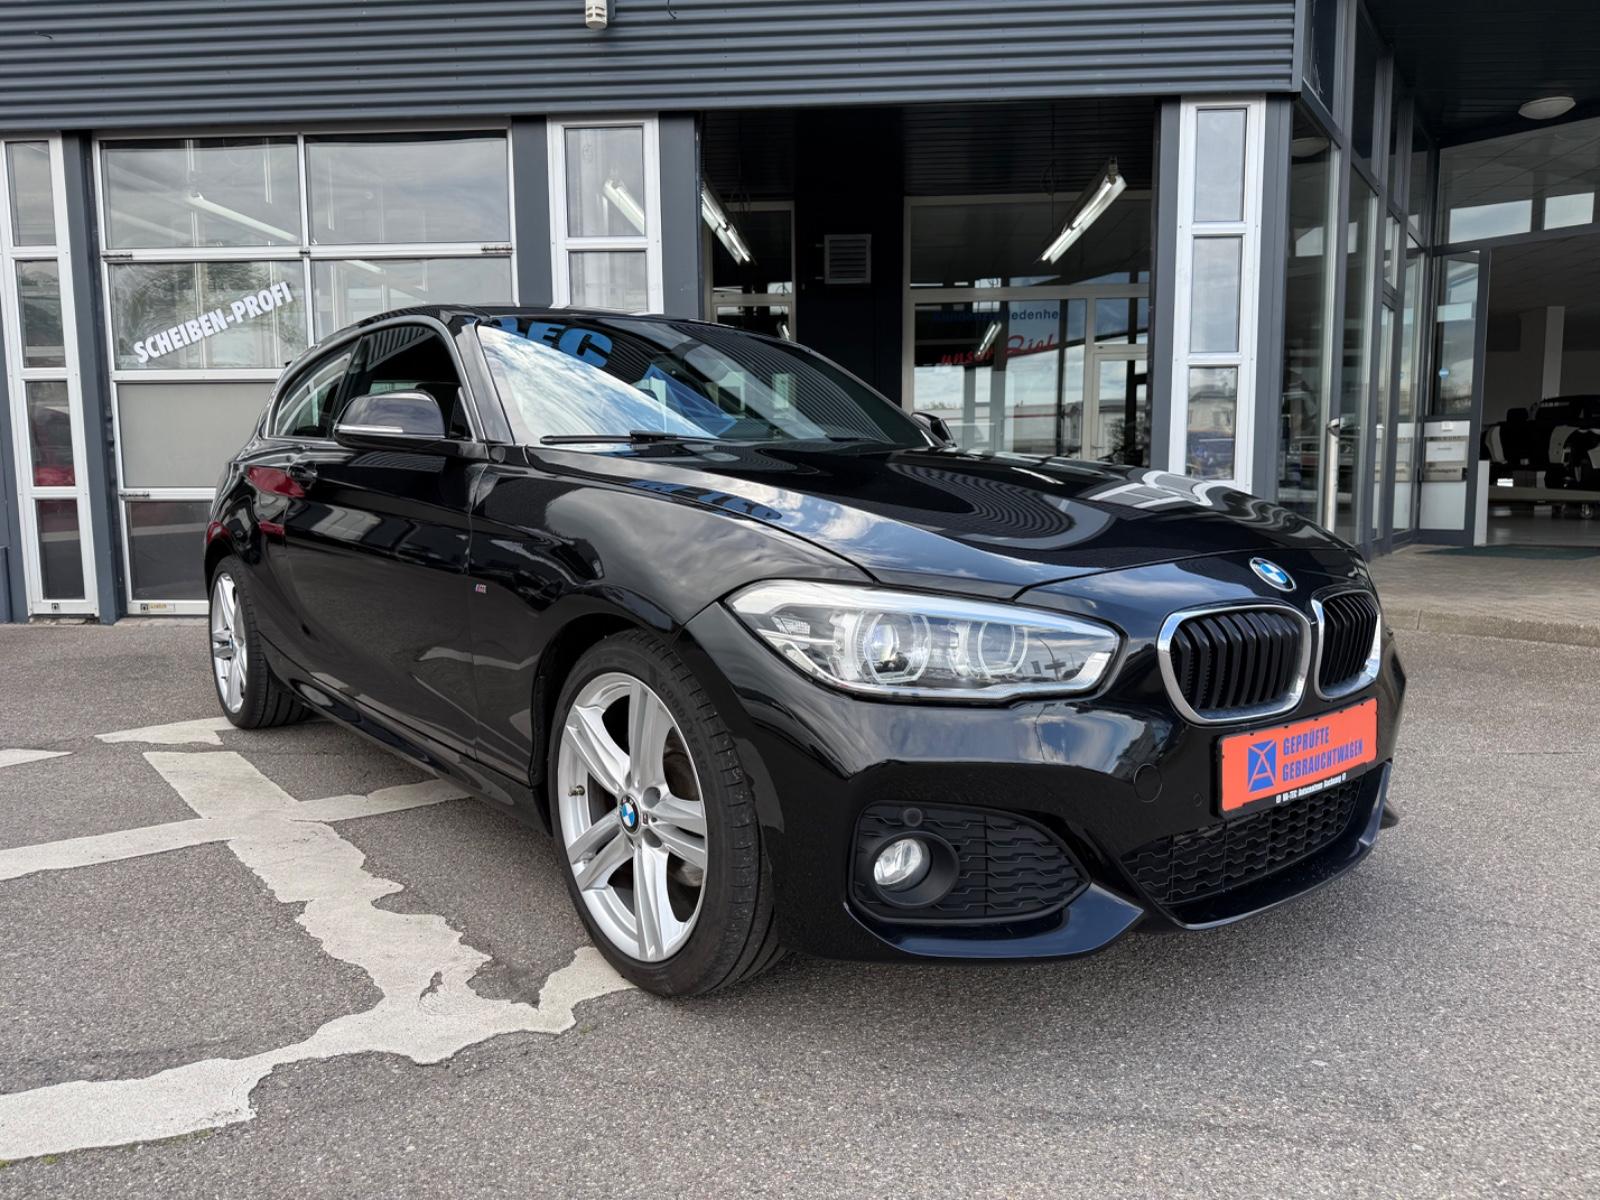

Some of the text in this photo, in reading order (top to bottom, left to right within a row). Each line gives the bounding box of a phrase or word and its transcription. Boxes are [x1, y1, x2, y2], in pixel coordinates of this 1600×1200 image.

[133, 281, 293, 363] SCHEIBEN-PROFI
[1282, 726, 1330, 756] GEPRÜFTE
[1282, 738, 1364, 782] GEBRAUCHTWAGEN
